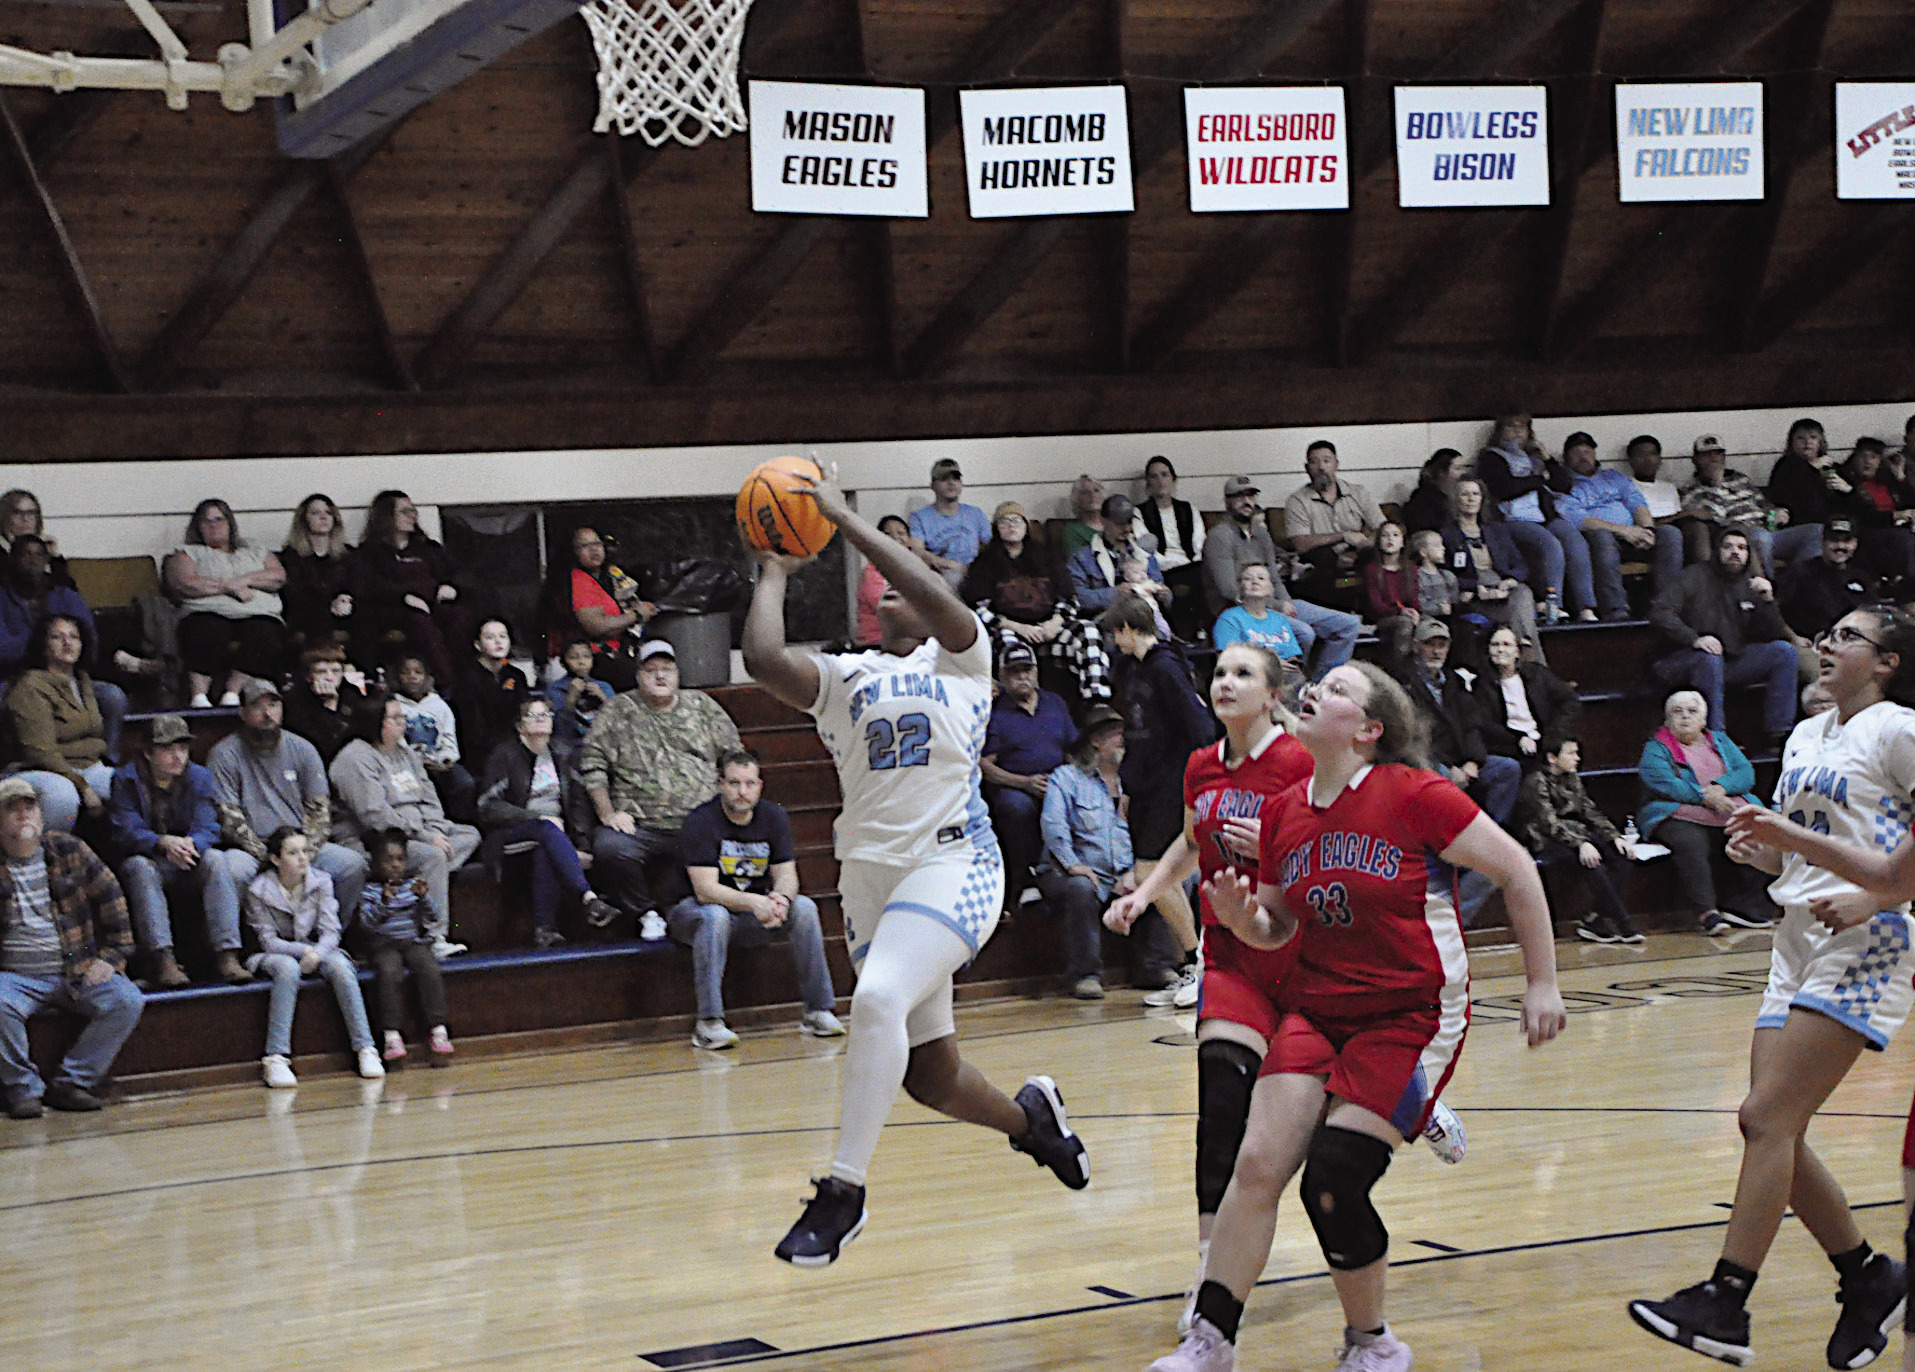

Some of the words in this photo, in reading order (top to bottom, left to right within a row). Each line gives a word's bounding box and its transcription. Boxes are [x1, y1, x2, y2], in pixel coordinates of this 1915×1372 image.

[782, 109, 895, 144] MASON
[982, 112, 1106, 146] MACOMB
[1198, 112, 1336, 142] EARLSBORO
[1406, 111, 1538, 140] BOWLEGS
[1626, 106, 1691, 137] NEW
[1692, 105, 1755, 136] LIMA
[781, 154, 899, 188] EAGLES
[980, 156, 1116, 190] HORNETS
[1199, 155, 1338, 185] WILDCATS
[1433, 152, 1516, 181] BISON
[1634, 146, 1751, 178] FALCONS
[890, 672, 949, 708] LIMA
[864, 712, 930, 770] 22
[1216, 787, 1265, 820] EAGL
[1320, 830, 1404, 881] EAGLES
[1306, 881, 1354, 928] 33
